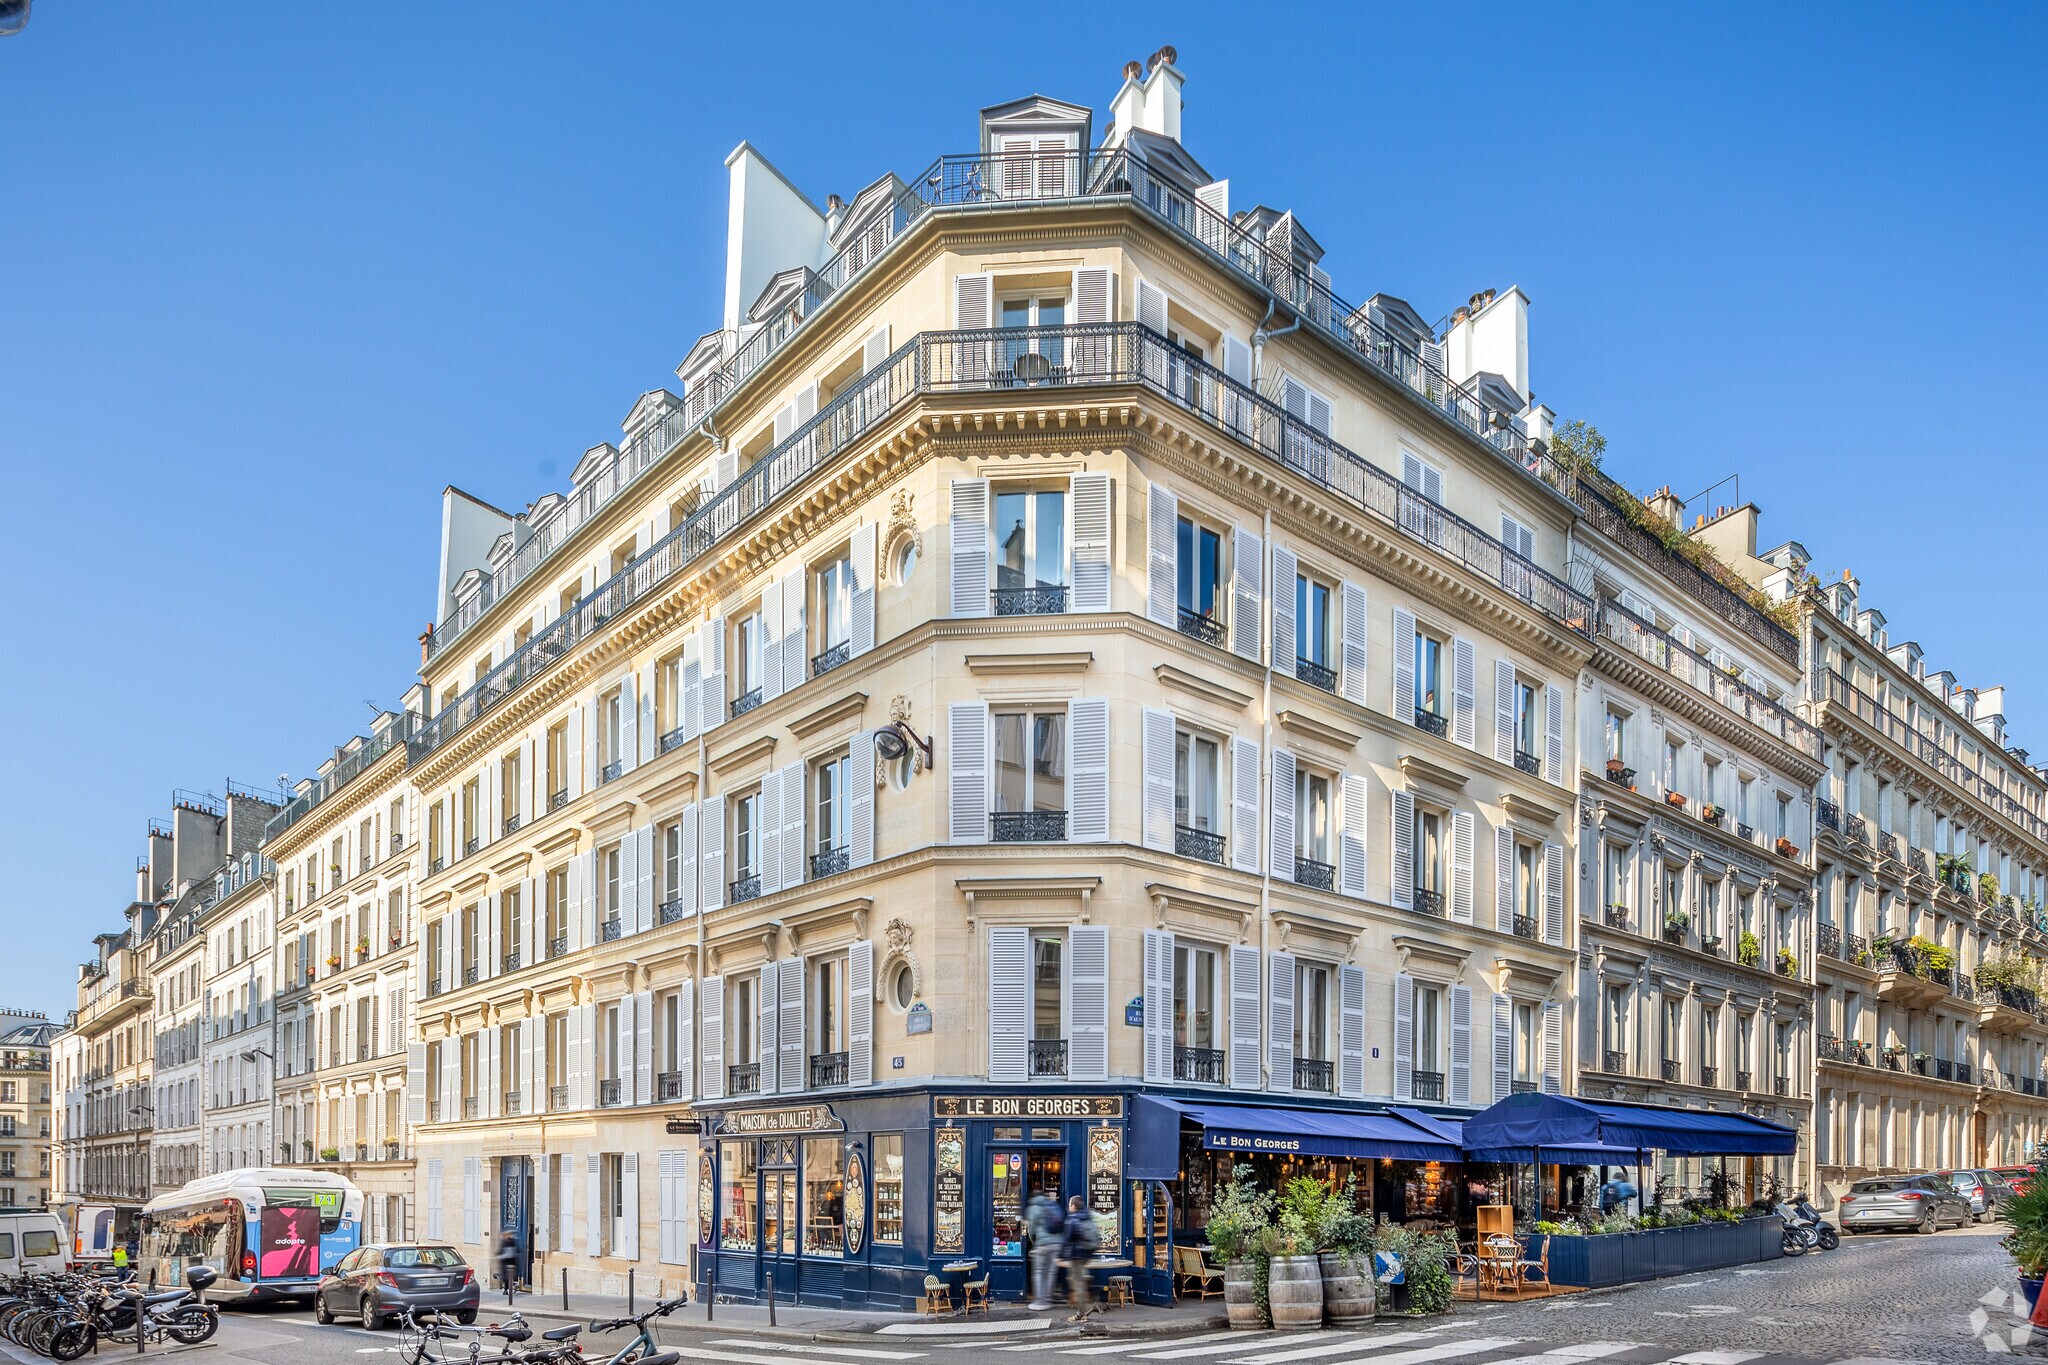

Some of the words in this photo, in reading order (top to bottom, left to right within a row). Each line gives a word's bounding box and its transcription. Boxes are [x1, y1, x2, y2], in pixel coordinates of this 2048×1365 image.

[893, 1058, 903, 1067] 45
[966, 1099, 985, 1115] LE
[992, 1099, 1020, 1115] BON
[1027, 1099, 1090, 1115] GEORGES
[740, 1114, 767, 1130] MAISON
[767, 1116, 778, 1129] de
